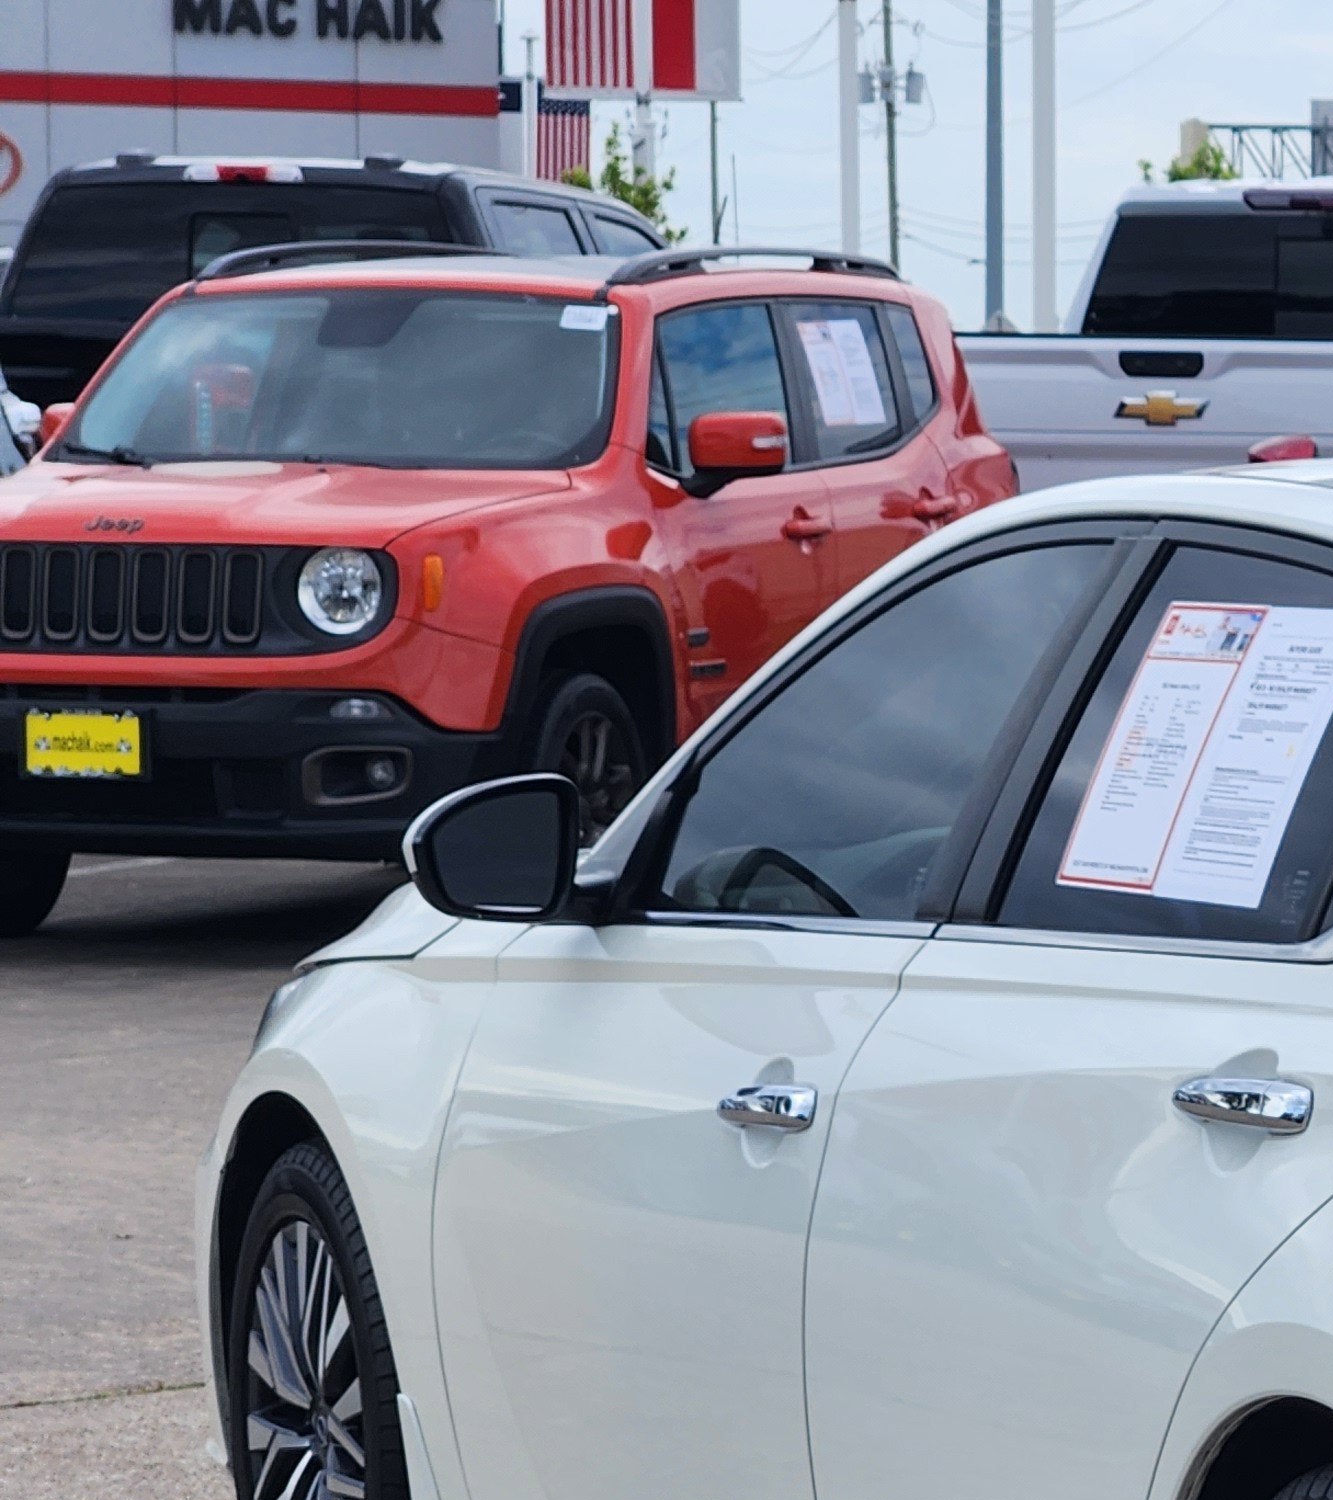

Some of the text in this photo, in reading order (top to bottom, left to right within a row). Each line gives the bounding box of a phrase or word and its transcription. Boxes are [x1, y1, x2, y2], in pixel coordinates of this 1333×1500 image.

[173, 0, 443, 43] MAC HAIK
[84, 515, 145, 535] Jeep
